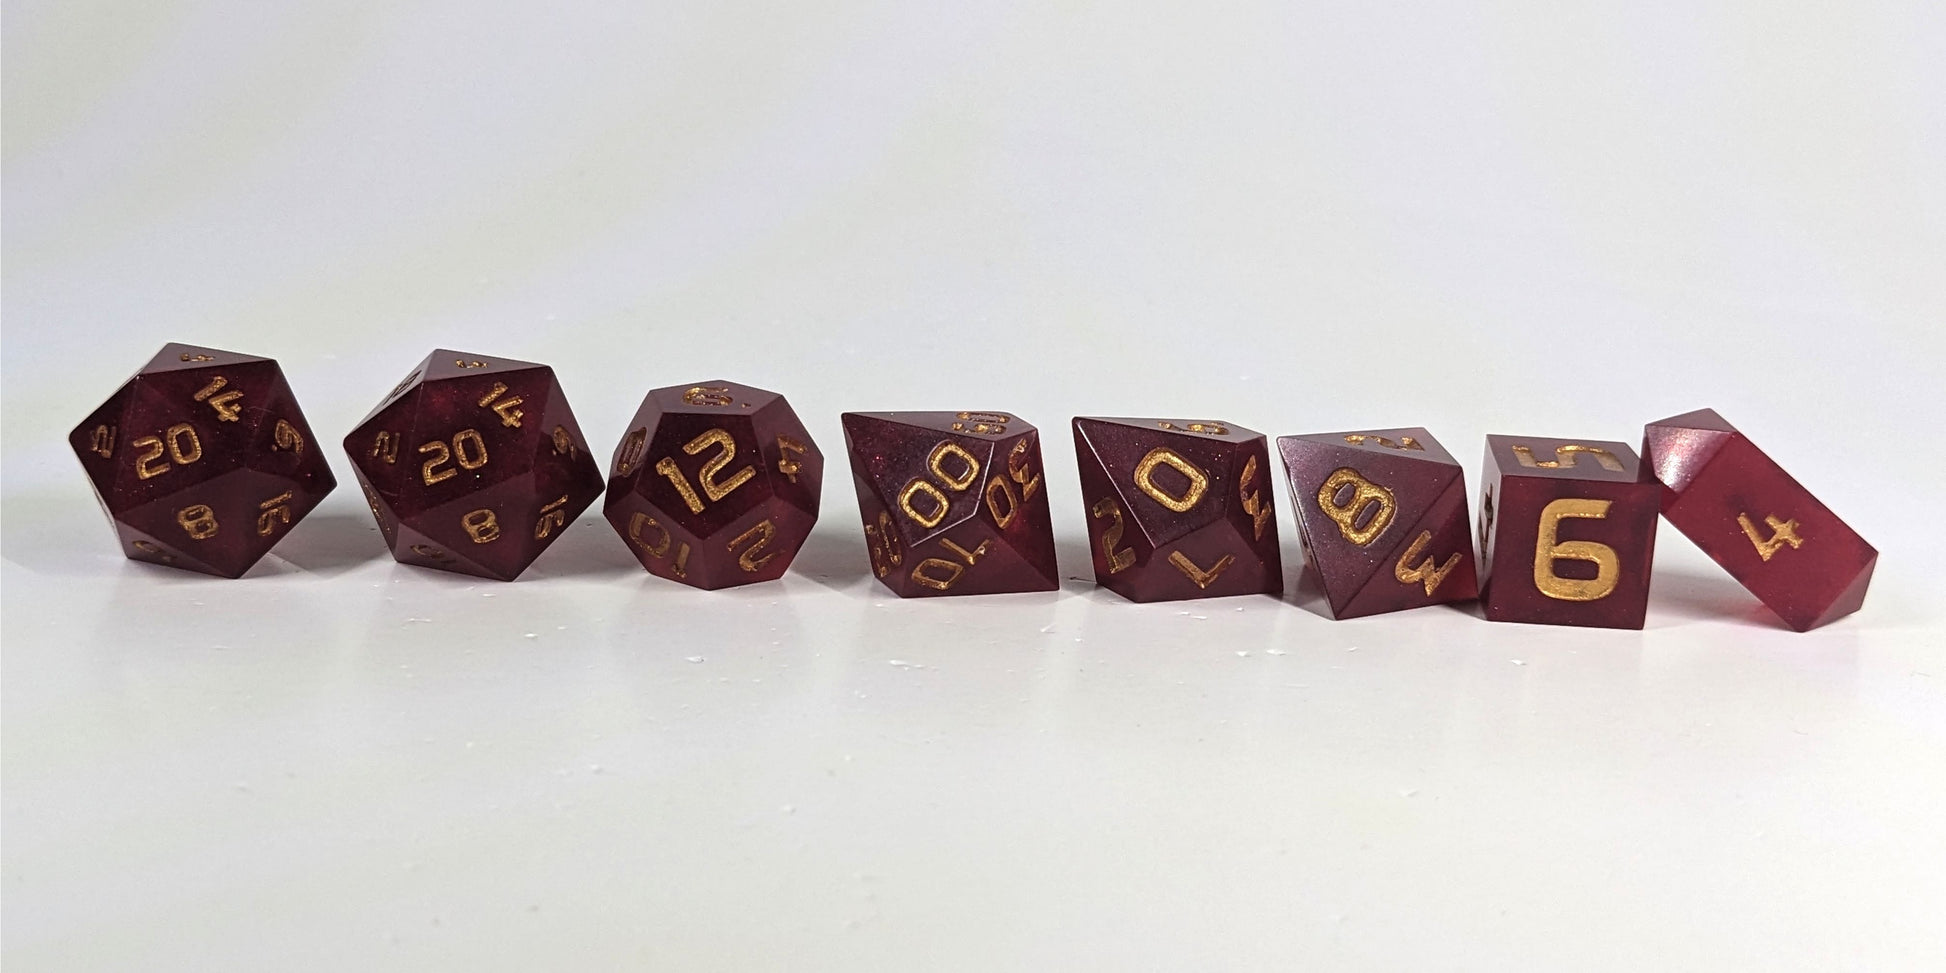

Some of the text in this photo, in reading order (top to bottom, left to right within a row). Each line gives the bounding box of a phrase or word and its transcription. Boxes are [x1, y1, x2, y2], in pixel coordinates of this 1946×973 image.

[194, 375, 245, 422] 14
[478, 381, 524, 428] 14
[132, 422, 202, 480] 20
[418, 428, 488, 486] 20
[655, 427, 757, 515] 12
[1133, 446, 1210, 513] 0
[1511, 443, 1625, 472] 5
[897, 438, 980, 529] 00
[1317, 466, 1398, 548] 8
[177, 504, 219, 540] 8
[460, 508, 500, 544] 8
[628, 511, 692, 579] 10
[726, 519, 786, 573] 2
[1092, 496, 1137, 575] 2
[1533, 498, 1621, 601] 6
[1736, 511, 1804, 562] 4
[1395, 530, 1463, 597] 3
